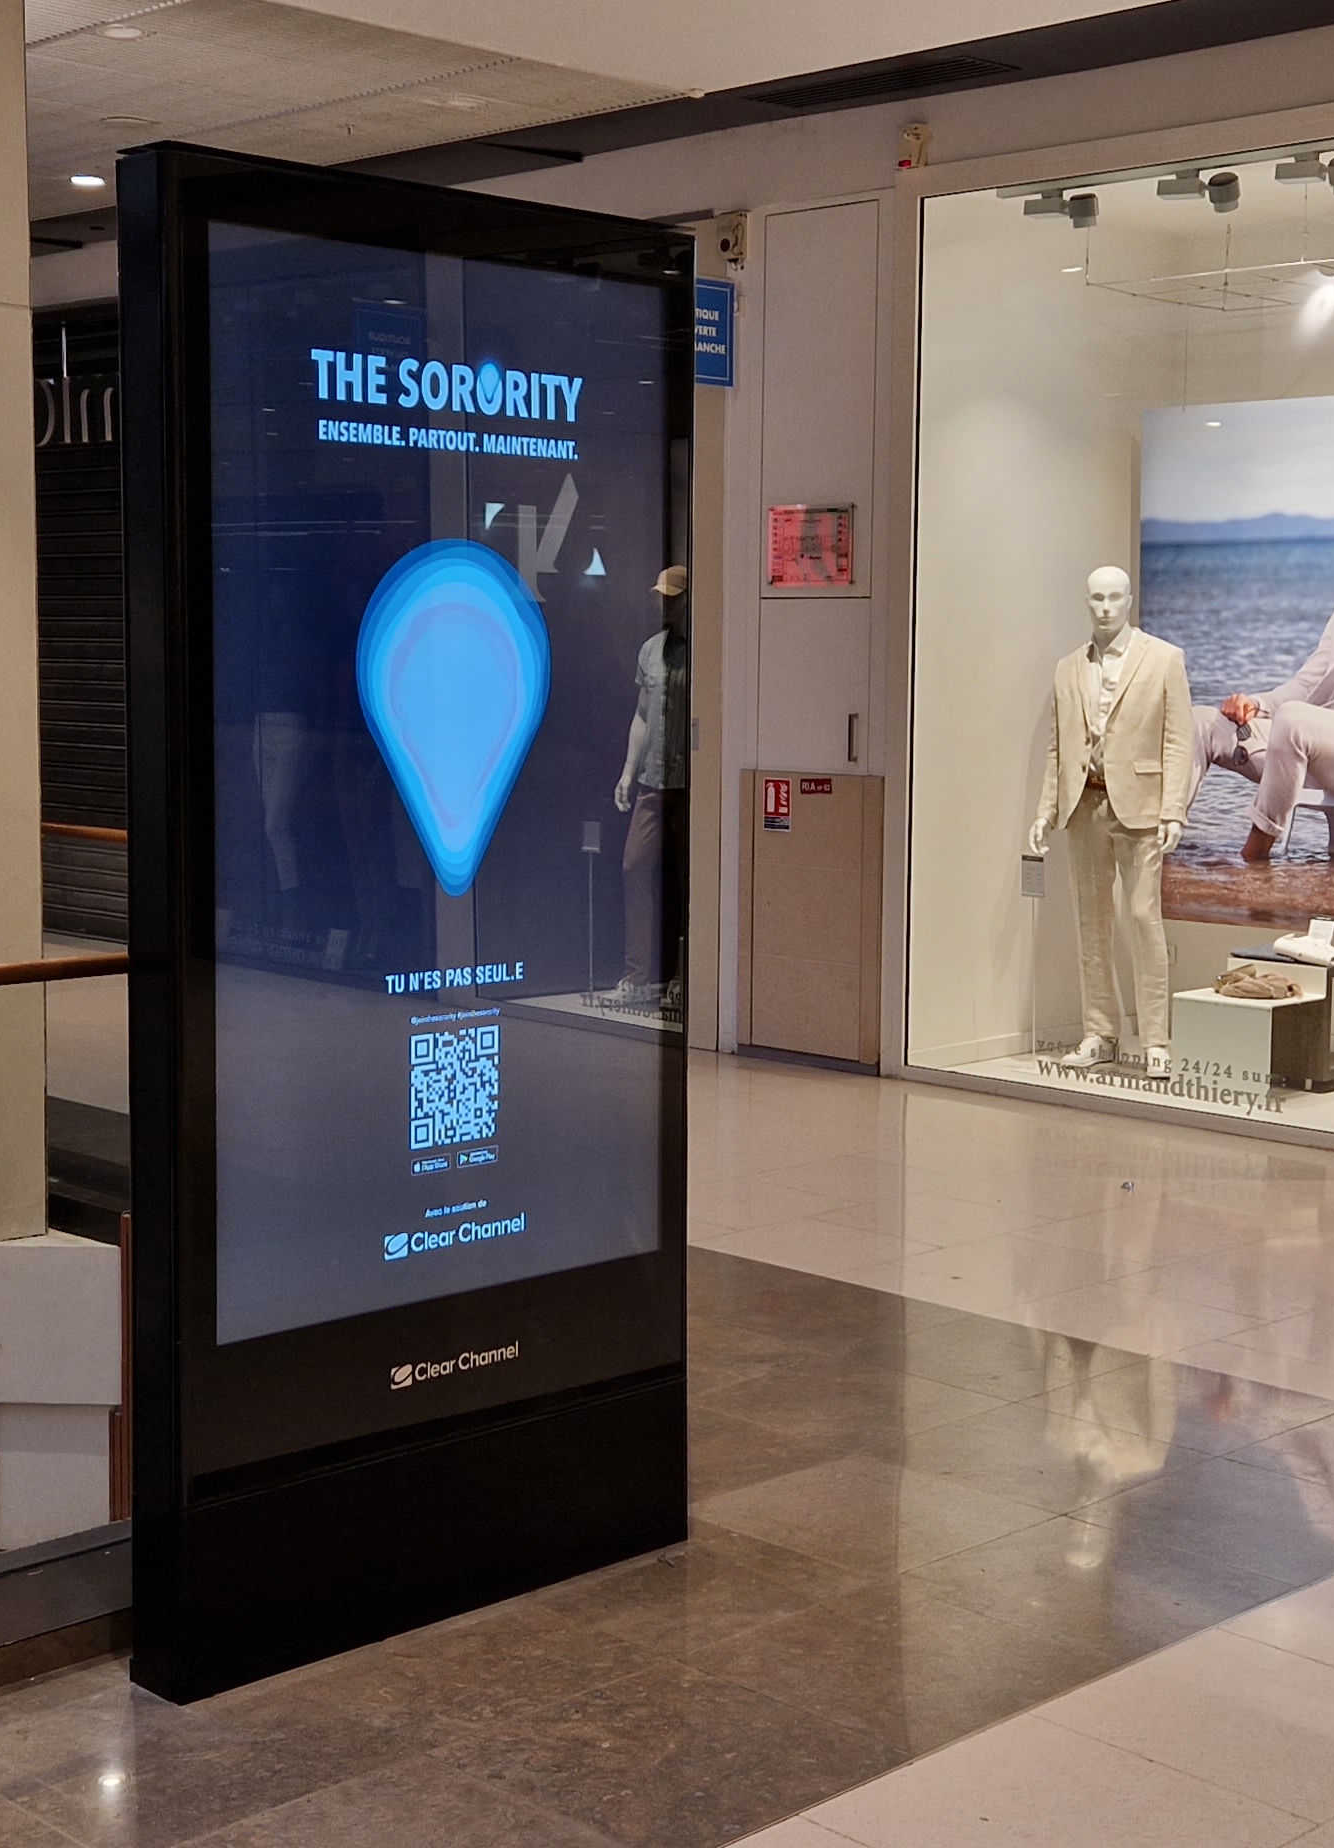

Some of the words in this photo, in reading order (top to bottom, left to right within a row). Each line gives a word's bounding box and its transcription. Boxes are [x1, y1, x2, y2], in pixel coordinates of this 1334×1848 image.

[311, 349, 387, 405] THE
[398, 358, 583, 422] SORORITY
[318, 419, 406, 447] ENSEMBLE.
[409, 427, 480, 453] PARTOUT.
[483, 433, 579, 460] MAINTENANT.
[385, 974, 405, 994] TU
[409, 970, 442, 992] N'ES
[445, 967, 472, 987] PAS
[475, 961, 524, 985] SEUL.E
[1037, 1039, 1082, 1055] votre
[1090, 1044, 1173, 1074] shopping
[1181, 1058, 1233, 1079] 24/24
[1036, 1059, 1287, 1116] www.armandthiery.fr
[410, 1229, 457, 1252] Clear
[458, 1212, 525, 1243] Channel
[414, 1359, 457, 1381] Clear
[457, 1340, 519, 1370] Channel
